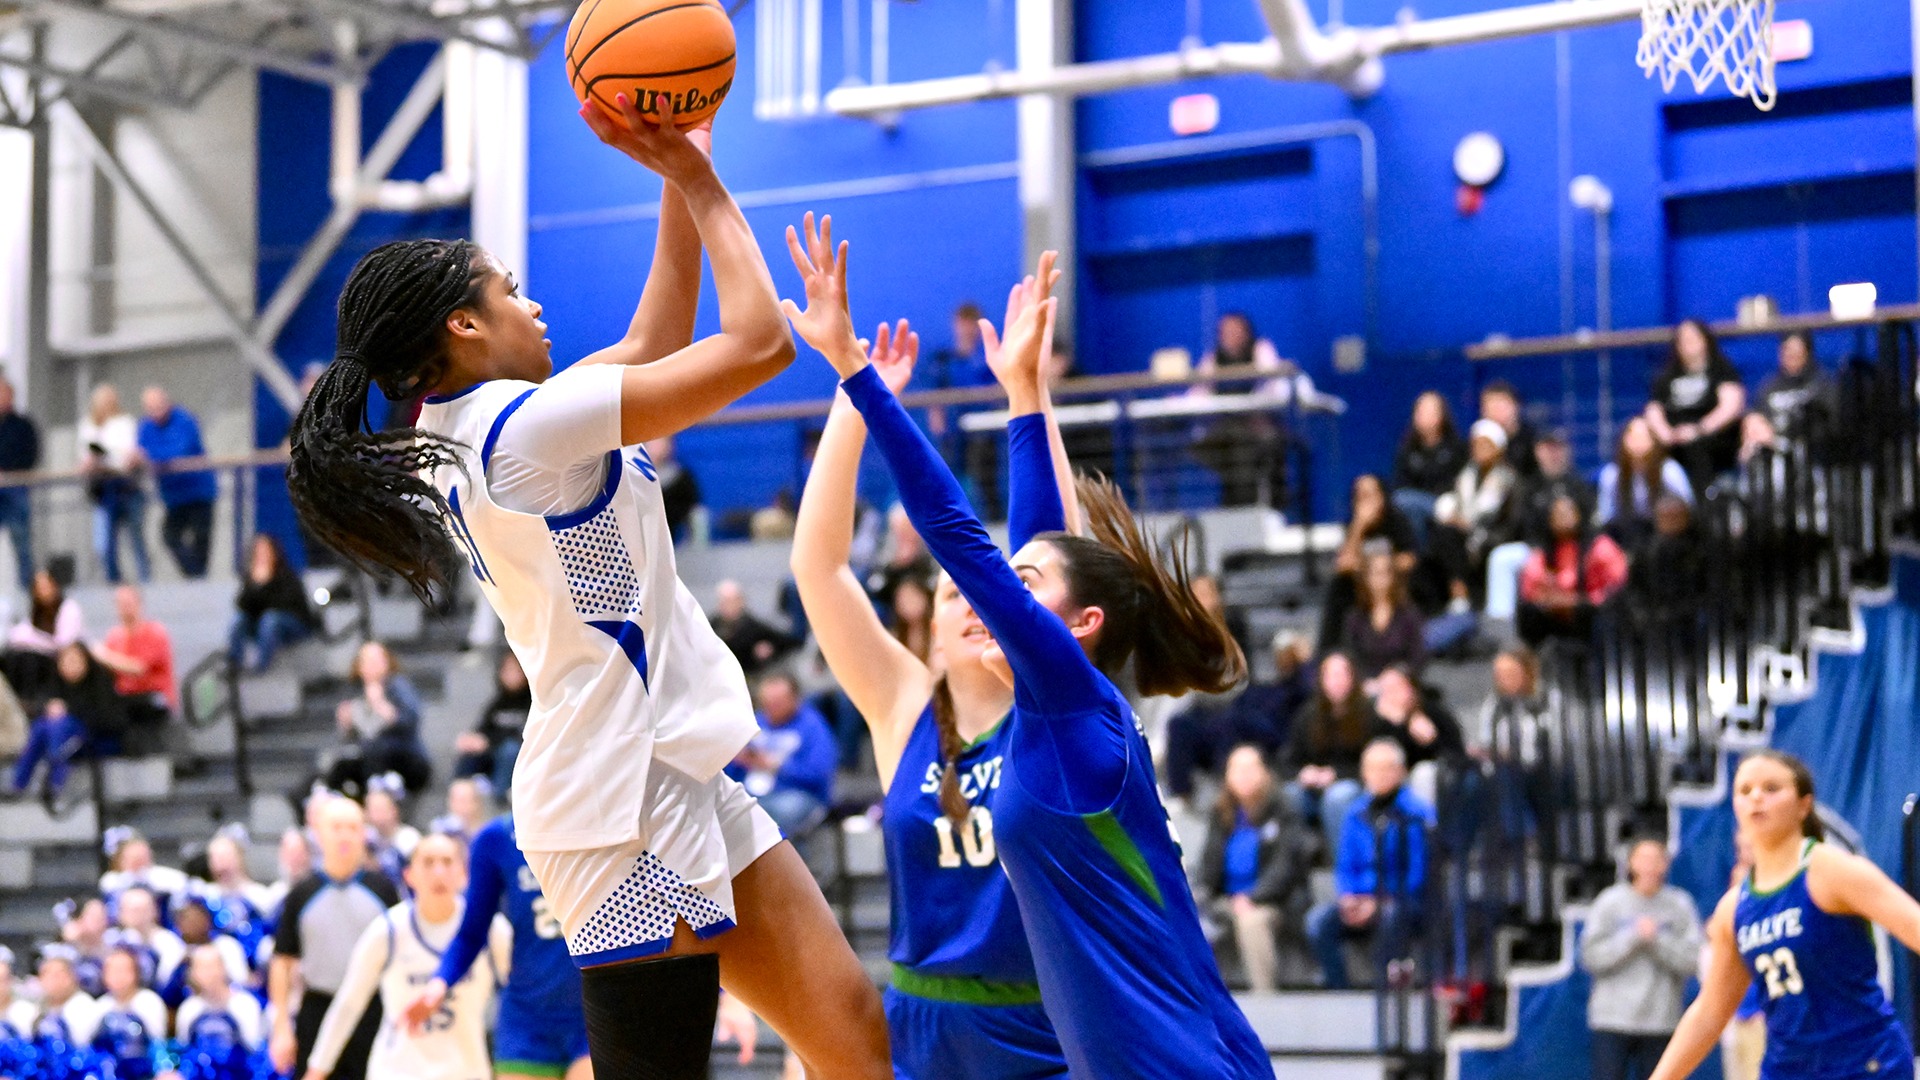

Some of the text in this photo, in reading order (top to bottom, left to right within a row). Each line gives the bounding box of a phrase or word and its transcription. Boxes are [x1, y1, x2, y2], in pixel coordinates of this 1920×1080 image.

[934, 805, 995, 867] 10
[1737, 906, 1804, 954] SALVE
[1755, 947, 1804, 1000] 23
